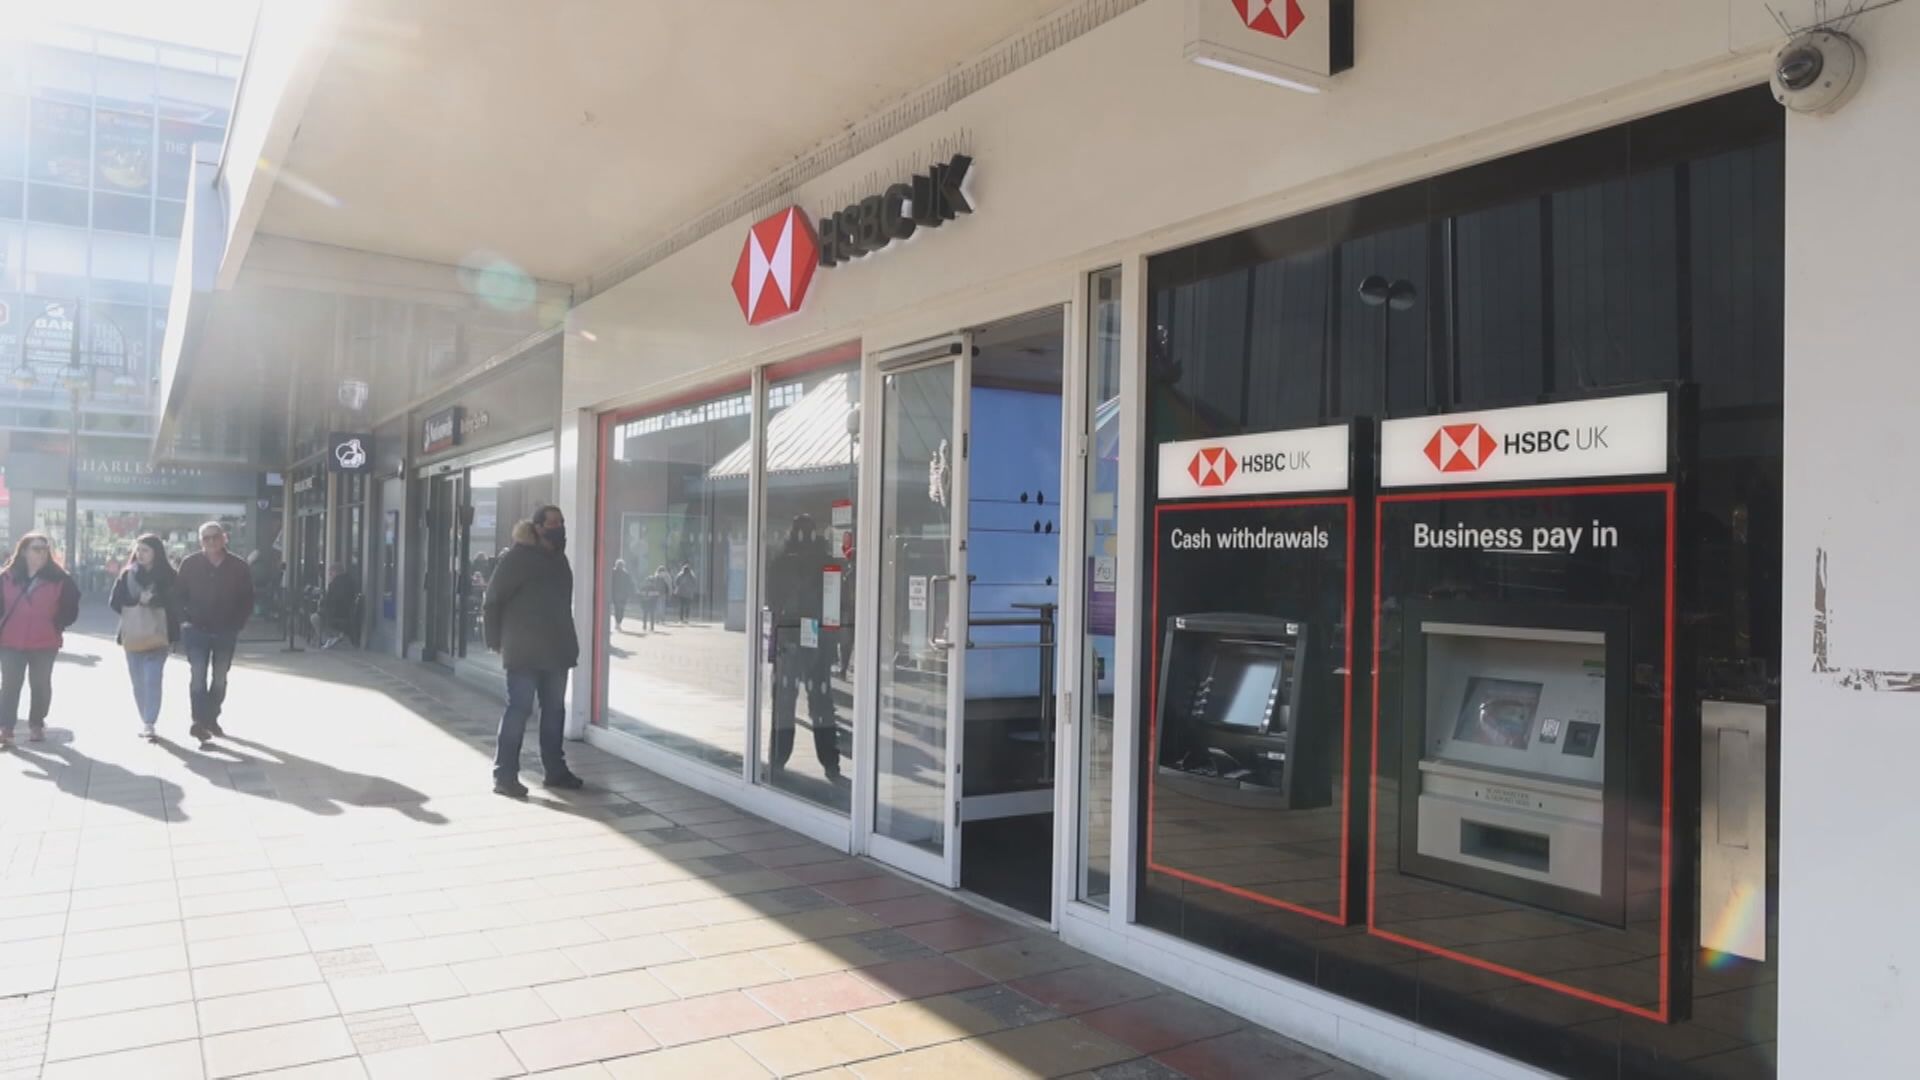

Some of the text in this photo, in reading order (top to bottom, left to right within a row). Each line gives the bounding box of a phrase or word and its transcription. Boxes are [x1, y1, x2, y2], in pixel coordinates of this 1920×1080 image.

[819, 154, 973, 267] HSBC UK
[1503, 425, 1609, 455] HSBC UK
[1241, 450, 1311, 474] HSBC UK
[1171, 524, 1329, 549] Cash withdrawals
[1414, 519, 1618, 554] Business pay in
